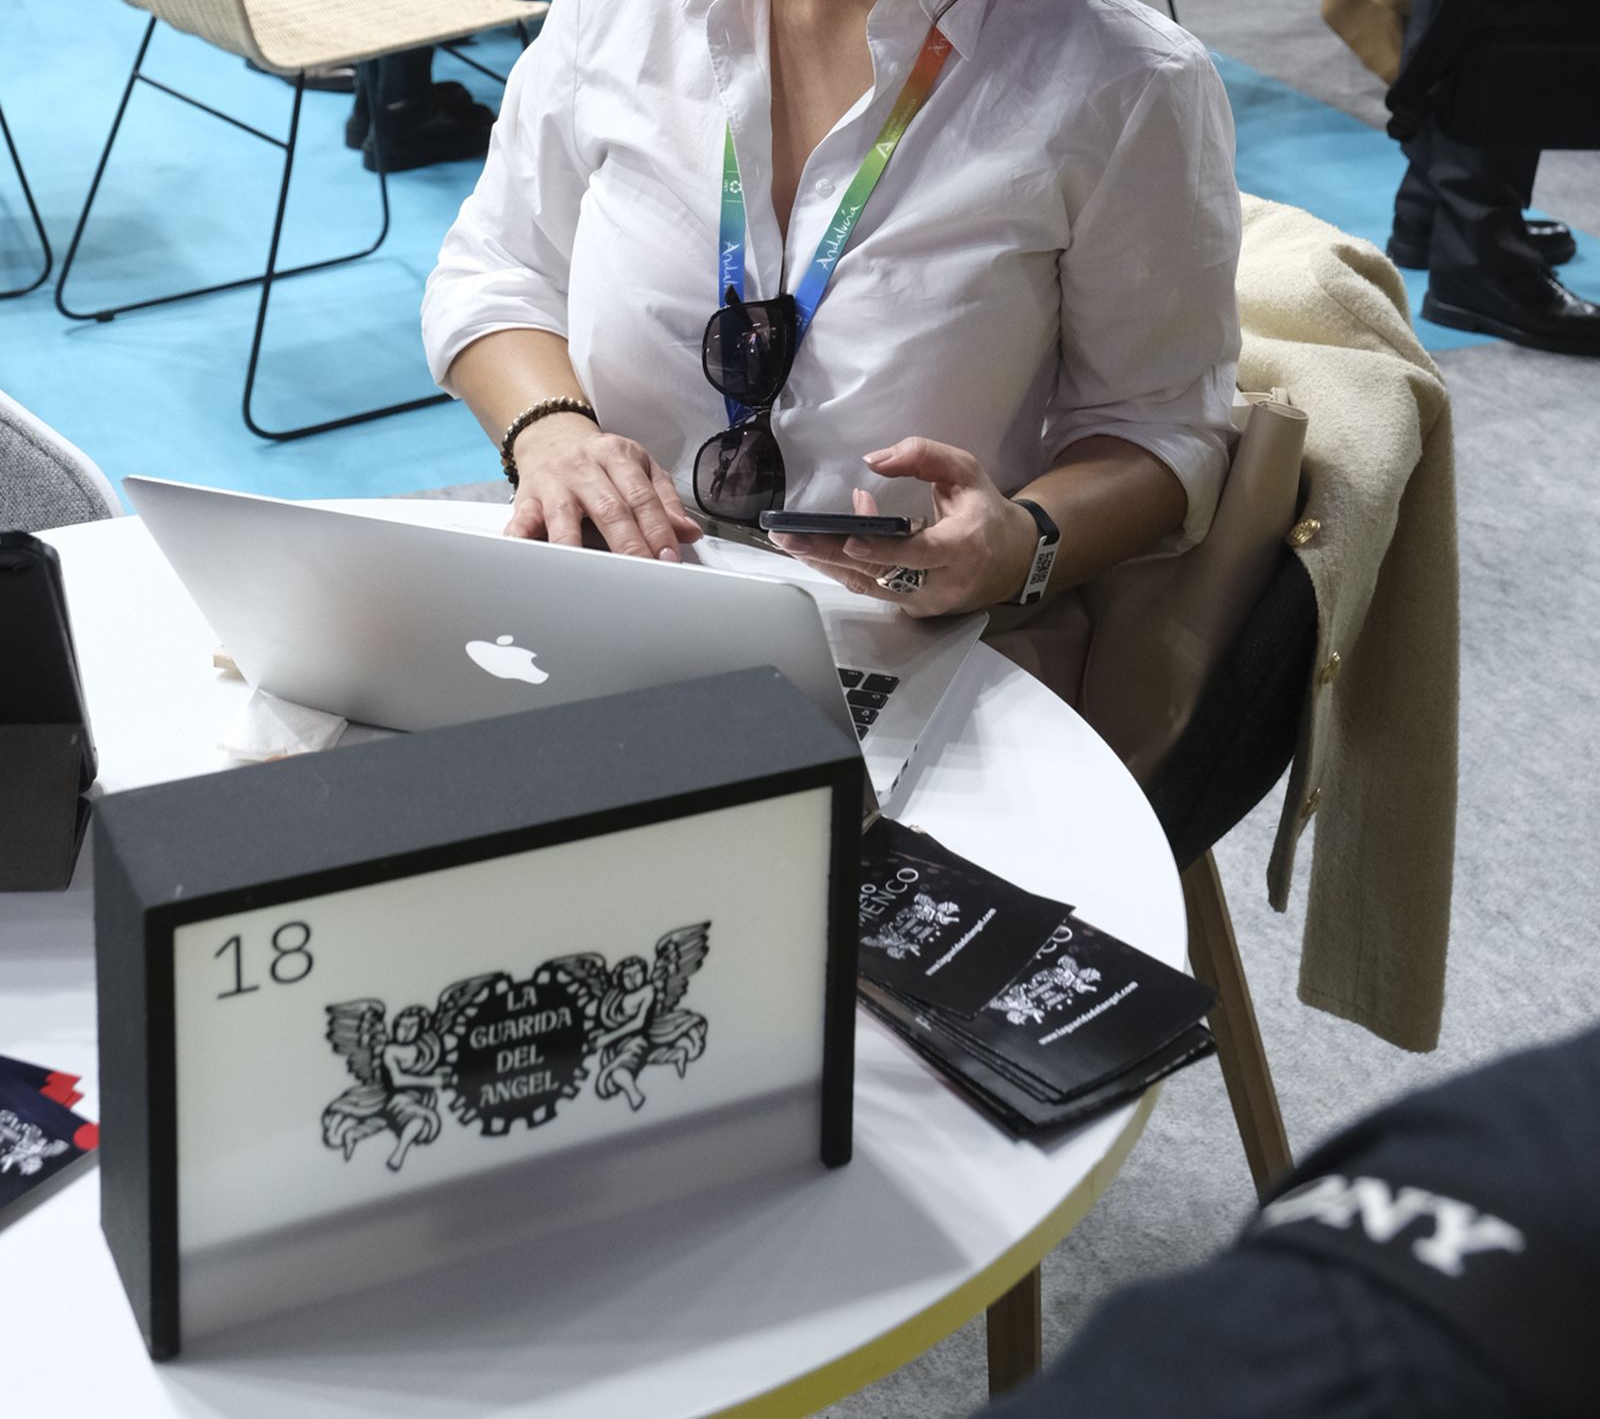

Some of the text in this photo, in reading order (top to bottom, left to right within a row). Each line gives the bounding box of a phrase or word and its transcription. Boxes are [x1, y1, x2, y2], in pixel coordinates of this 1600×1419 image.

[215, 920, 314, 1000] 18
[506, 985, 538, 1012] LA
[469, 1006, 573, 1050] GUARIDA
[496, 1044, 545, 1073] DEL
[479, 1070, 560, 1108] ANGEL
